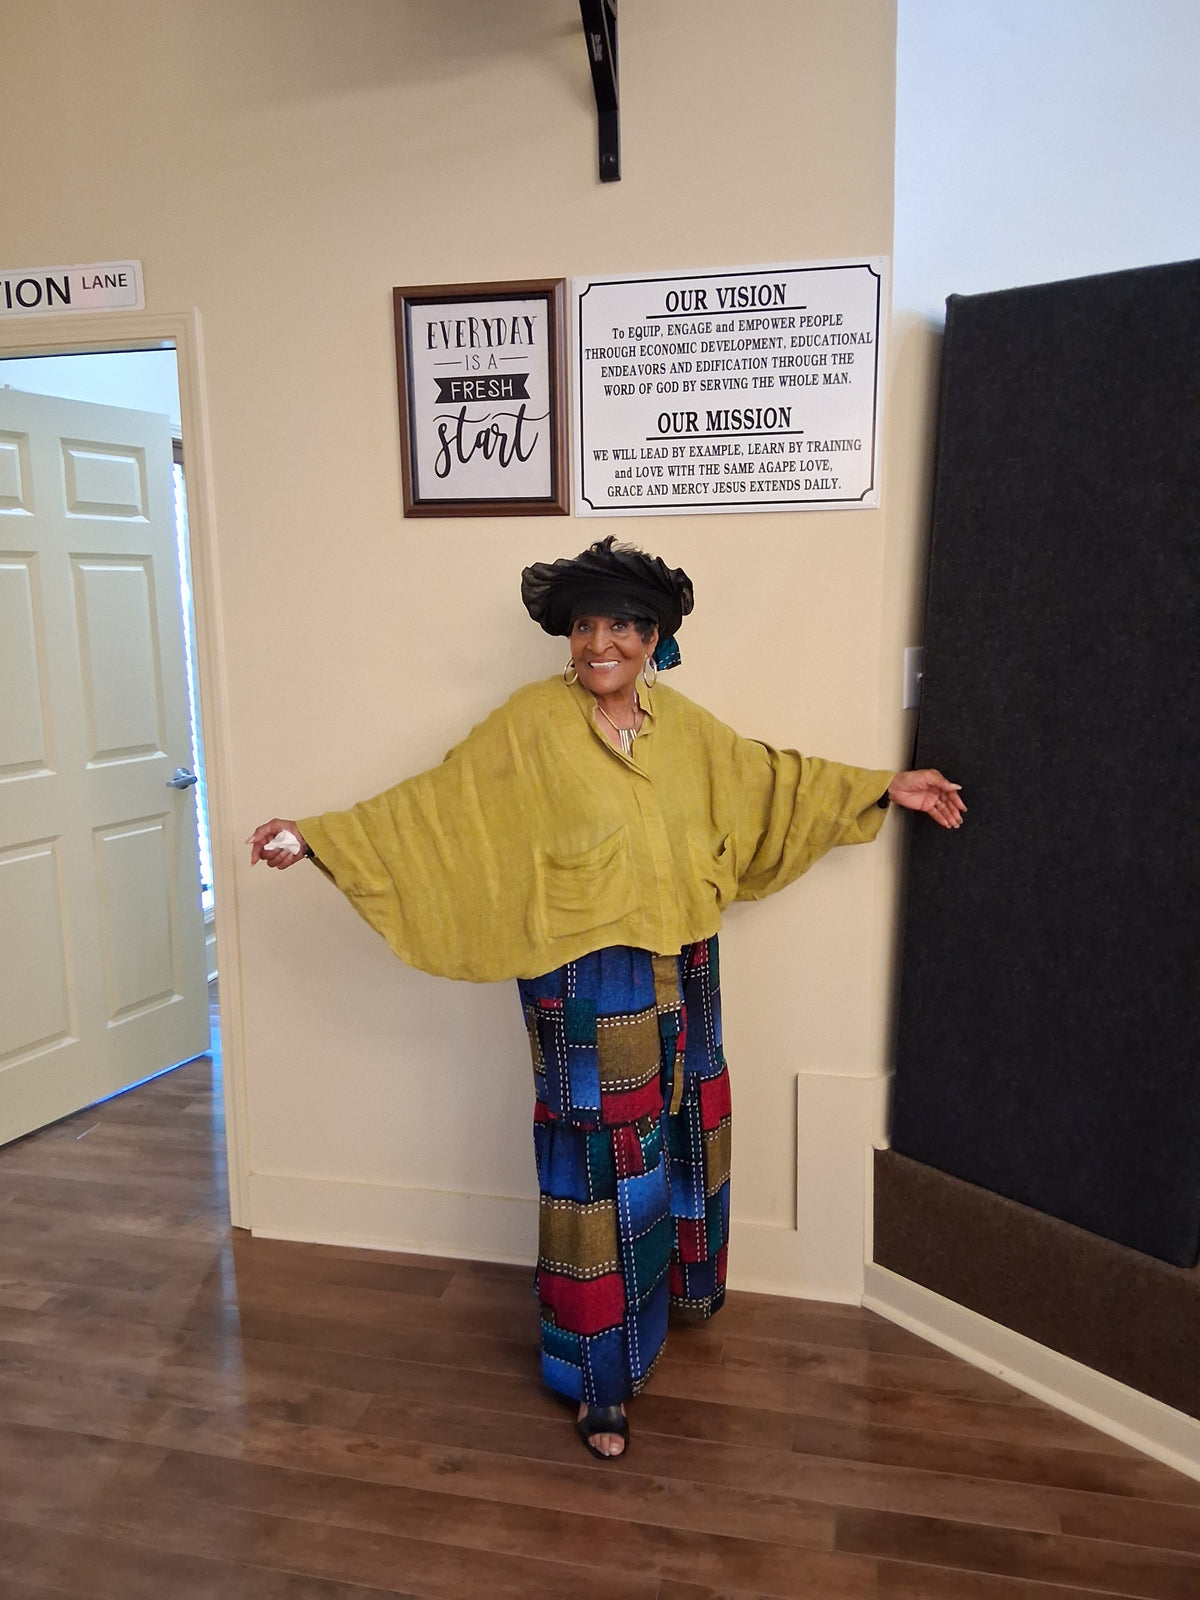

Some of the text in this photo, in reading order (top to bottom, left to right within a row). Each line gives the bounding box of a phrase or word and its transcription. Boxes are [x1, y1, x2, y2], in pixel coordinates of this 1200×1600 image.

[0, 273, 128, 309] ION LANE
[665, 283, 787, 313] OUR VISION
[426, 315, 538, 350] EVERYDAY
[612, 314, 844, 342] To EQUIP, ENGAGE and EMPOWER PEOPLE
[585, 331, 873, 360] THROUGH ECONOMIC DEVELOPMENT, EDUCATIONAL
[464, 353, 498, 371] IS A
[600, 352, 855, 378] ENDEAVORS AND EDIFICATION THROUGH THE
[450, 378, 513, 401] FRESH
[604, 372, 852, 397] WORD OF GOD BY SERVING THE WHOLE MAN.
[657, 406, 793, 434] OUR MISSION
[432, 403, 551, 479] start
[593, 438, 862, 462] WE WILL LEAD BY EXAMPLE, LEARN BY TRAINING
[614, 459, 833, 479] and LOVE WITH THE SAME AGAPE LOVE,
[607, 477, 842, 498] GRACE AND MERCY JESUS EXTENDS DAILY.
